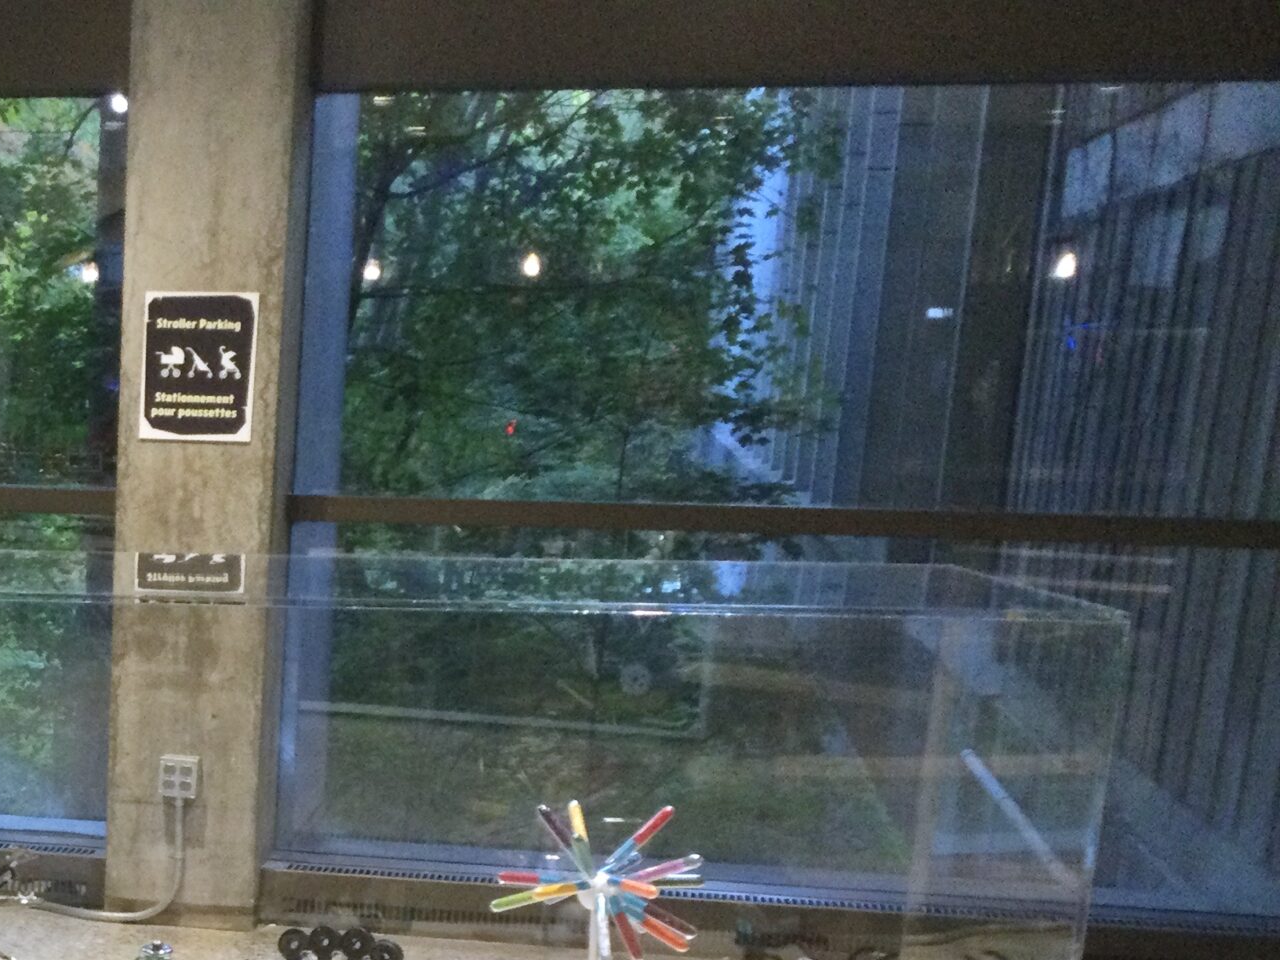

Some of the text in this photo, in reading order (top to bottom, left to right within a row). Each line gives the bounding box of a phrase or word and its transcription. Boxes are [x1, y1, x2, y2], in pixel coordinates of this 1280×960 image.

[156, 317, 242, 332] Stroller Parking
[155, 391, 235, 404] Stationnement
[151, 407, 237, 419] pour poussettes
